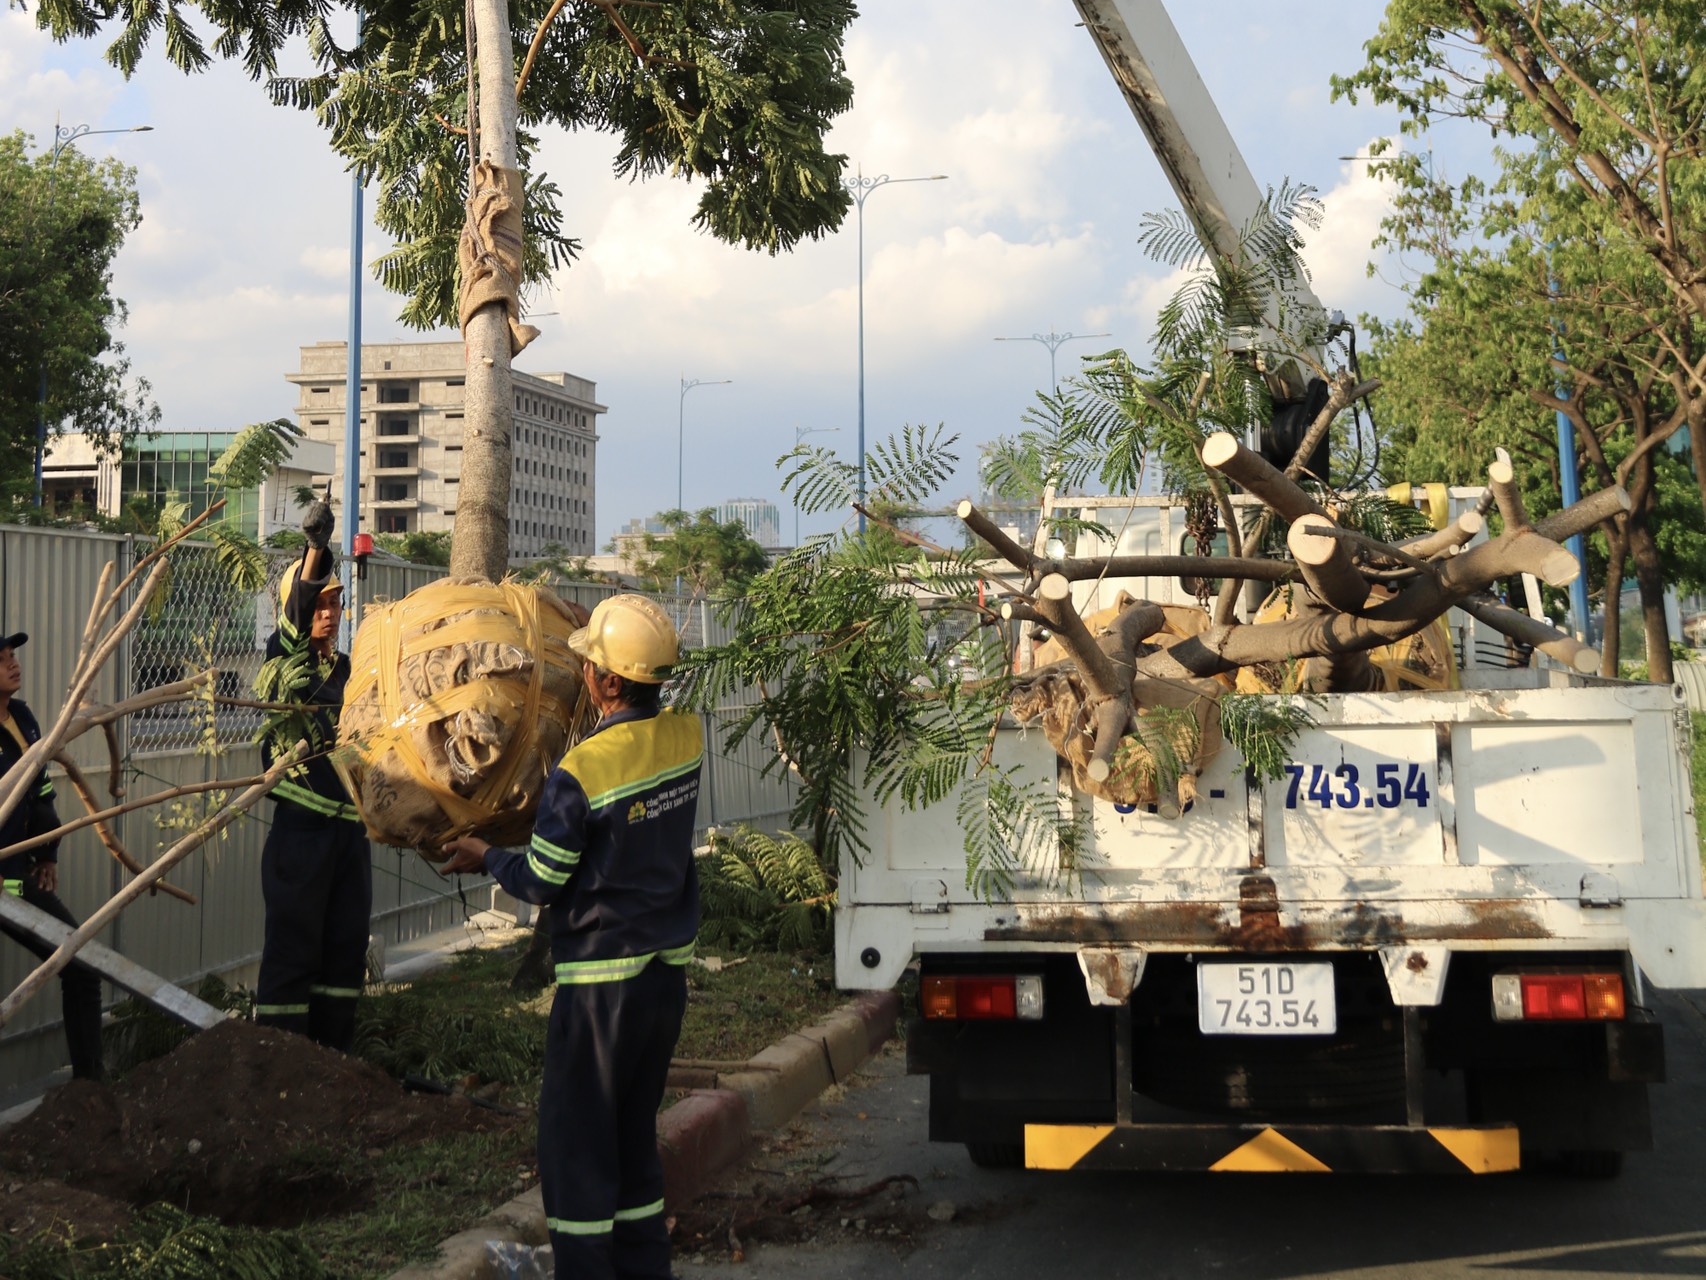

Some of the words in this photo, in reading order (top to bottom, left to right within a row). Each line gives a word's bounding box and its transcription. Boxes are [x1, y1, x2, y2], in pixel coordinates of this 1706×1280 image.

[1284, 763, 1430, 809] 743.54
[1238, 966, 1294, 995] 51D
[1215, 998, 1320, 1028] 743.54
